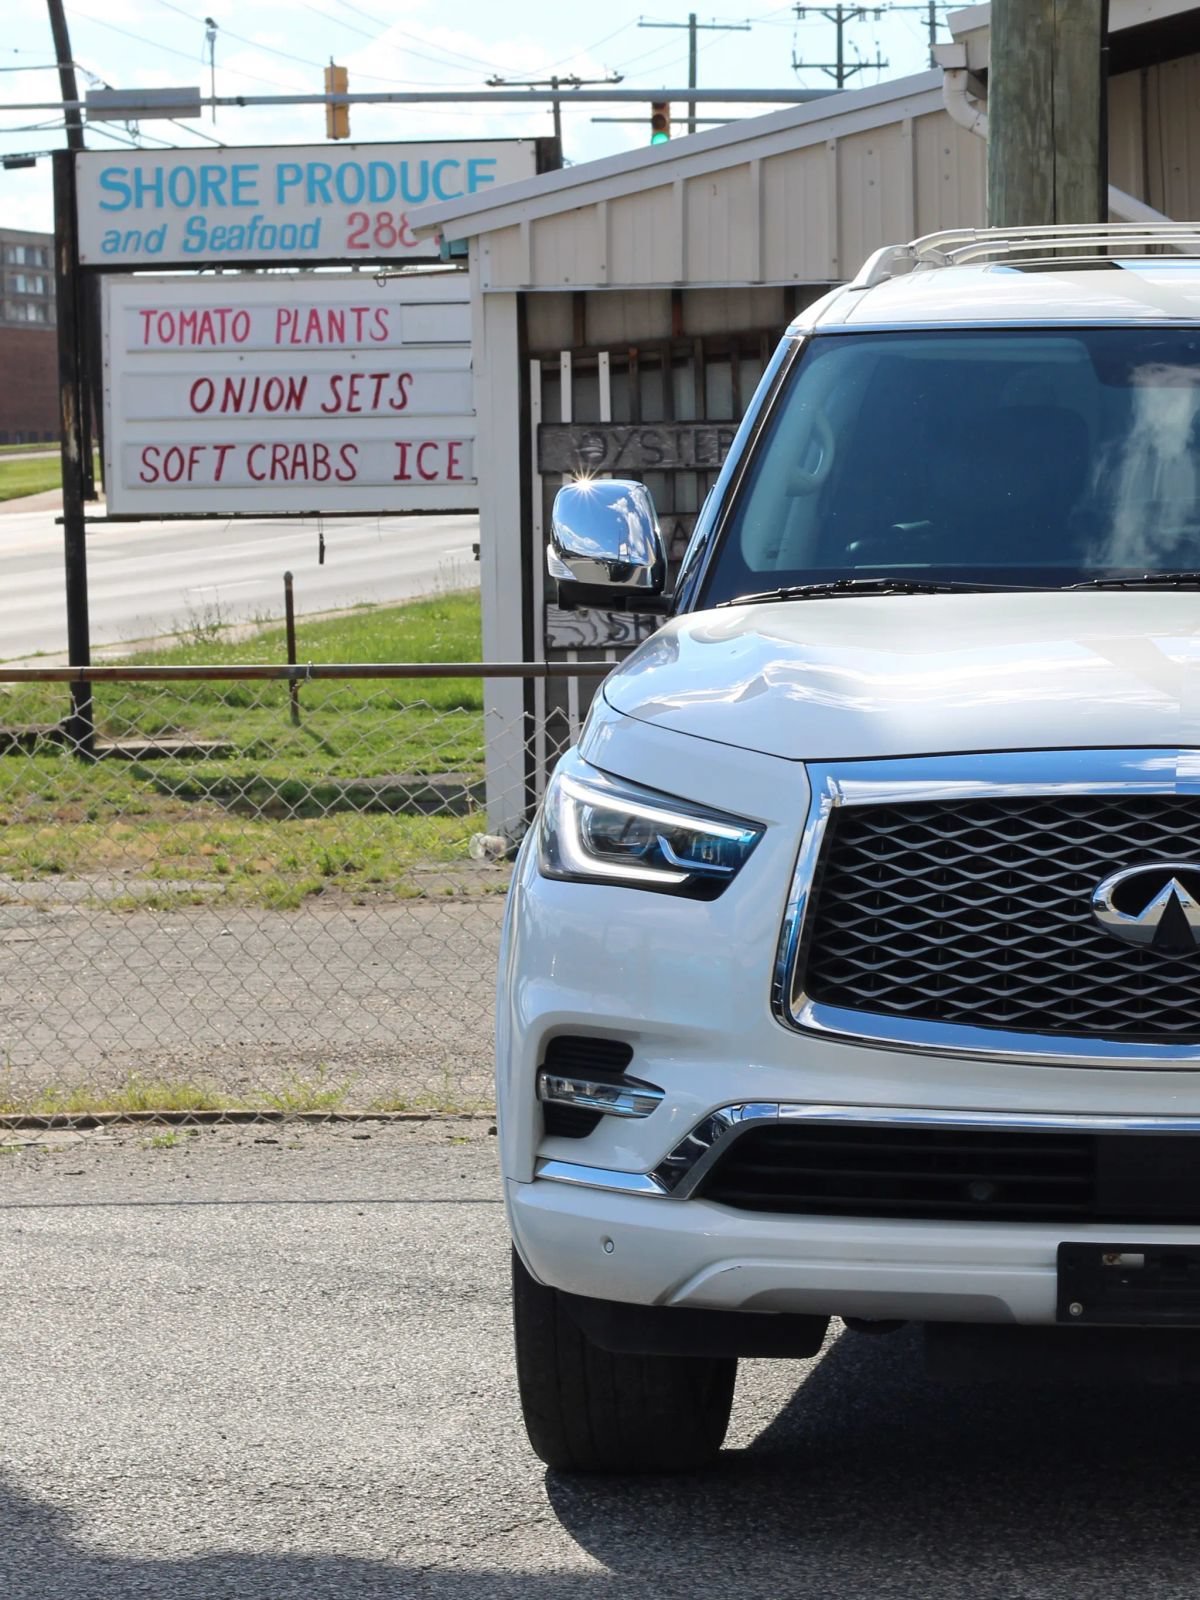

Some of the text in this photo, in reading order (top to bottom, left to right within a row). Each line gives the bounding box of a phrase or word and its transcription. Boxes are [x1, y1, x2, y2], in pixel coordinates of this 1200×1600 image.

[99, 158, 497, 212] SHORE PRODUCE
[101, 223, 168, 254] and
[182, 214, 322, 253] Seafood
[139, 307, 390, 346] TOMATO PLANTS
[189, 372, 414, 413] ONION SETS
[139, 441, 464, 483] SOFT CRABS ICE
